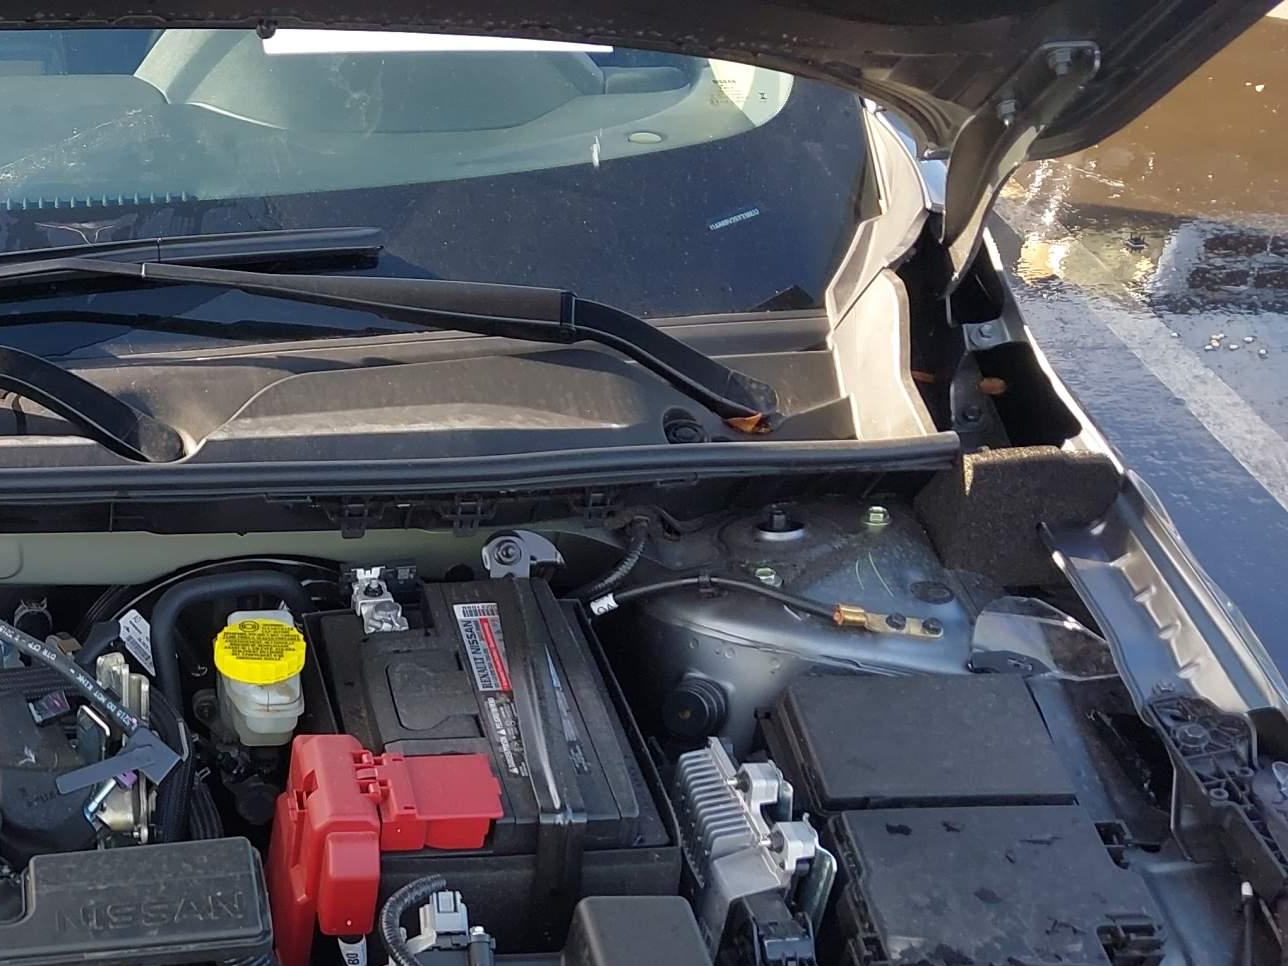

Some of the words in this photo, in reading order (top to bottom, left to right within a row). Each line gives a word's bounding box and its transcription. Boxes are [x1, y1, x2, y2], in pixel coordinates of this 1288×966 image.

[461, 620, 481, 654] NISSAN
[75, 673, 94, 692] KINK
[93, 690, 107, 704] NOT
[55, 891, 244, 932] NISSAN
